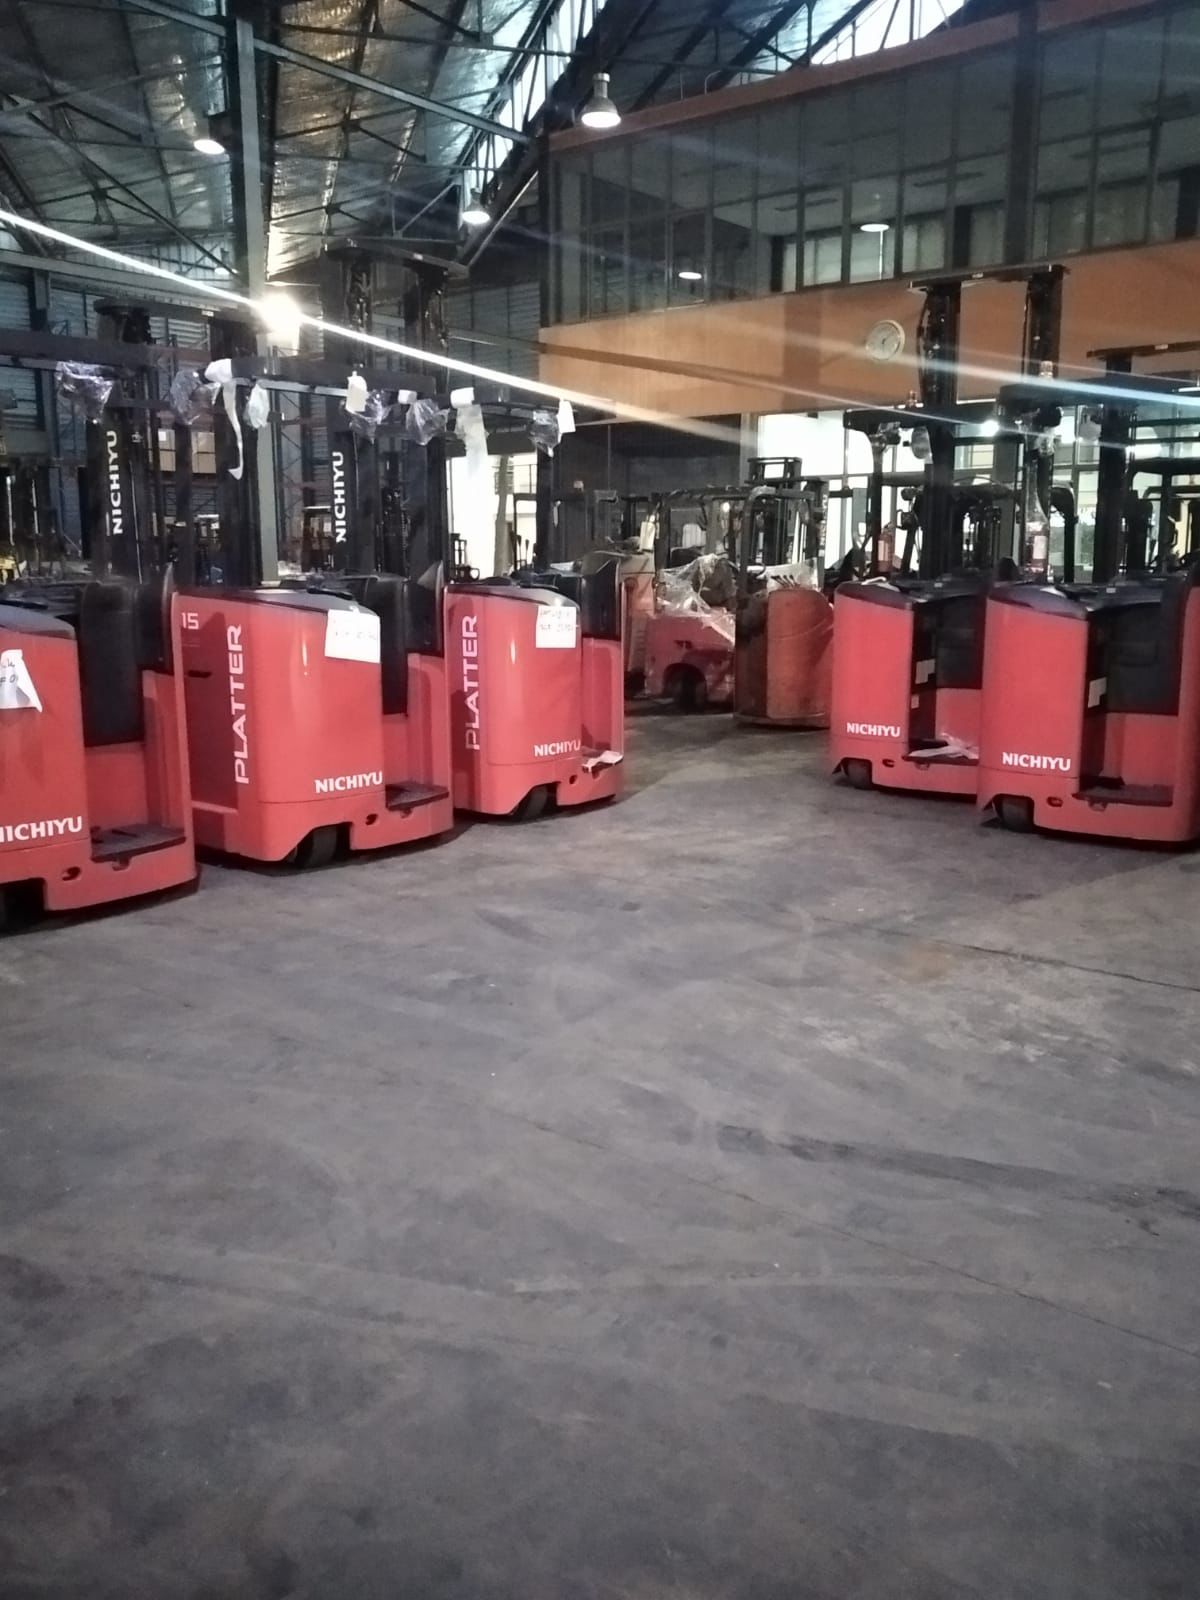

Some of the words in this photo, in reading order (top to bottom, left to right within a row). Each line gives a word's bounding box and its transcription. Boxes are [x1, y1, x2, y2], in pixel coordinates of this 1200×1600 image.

[106, 430, 123, 535] NICHIYU
[332, 451, 347, 543] NICHIYU
[182, 612, 200, 630] 15
[462, 615, 480, 751] PLATTER
[227, 624, 249, 784] PLATTER
[846, 722, 901, 738] NICHIYU
[534, 739, 581, 757] NICHIYU
[1002, 751, 1071, 771] NICHIYU
[314, 770, 383, 794] NICHIYU
